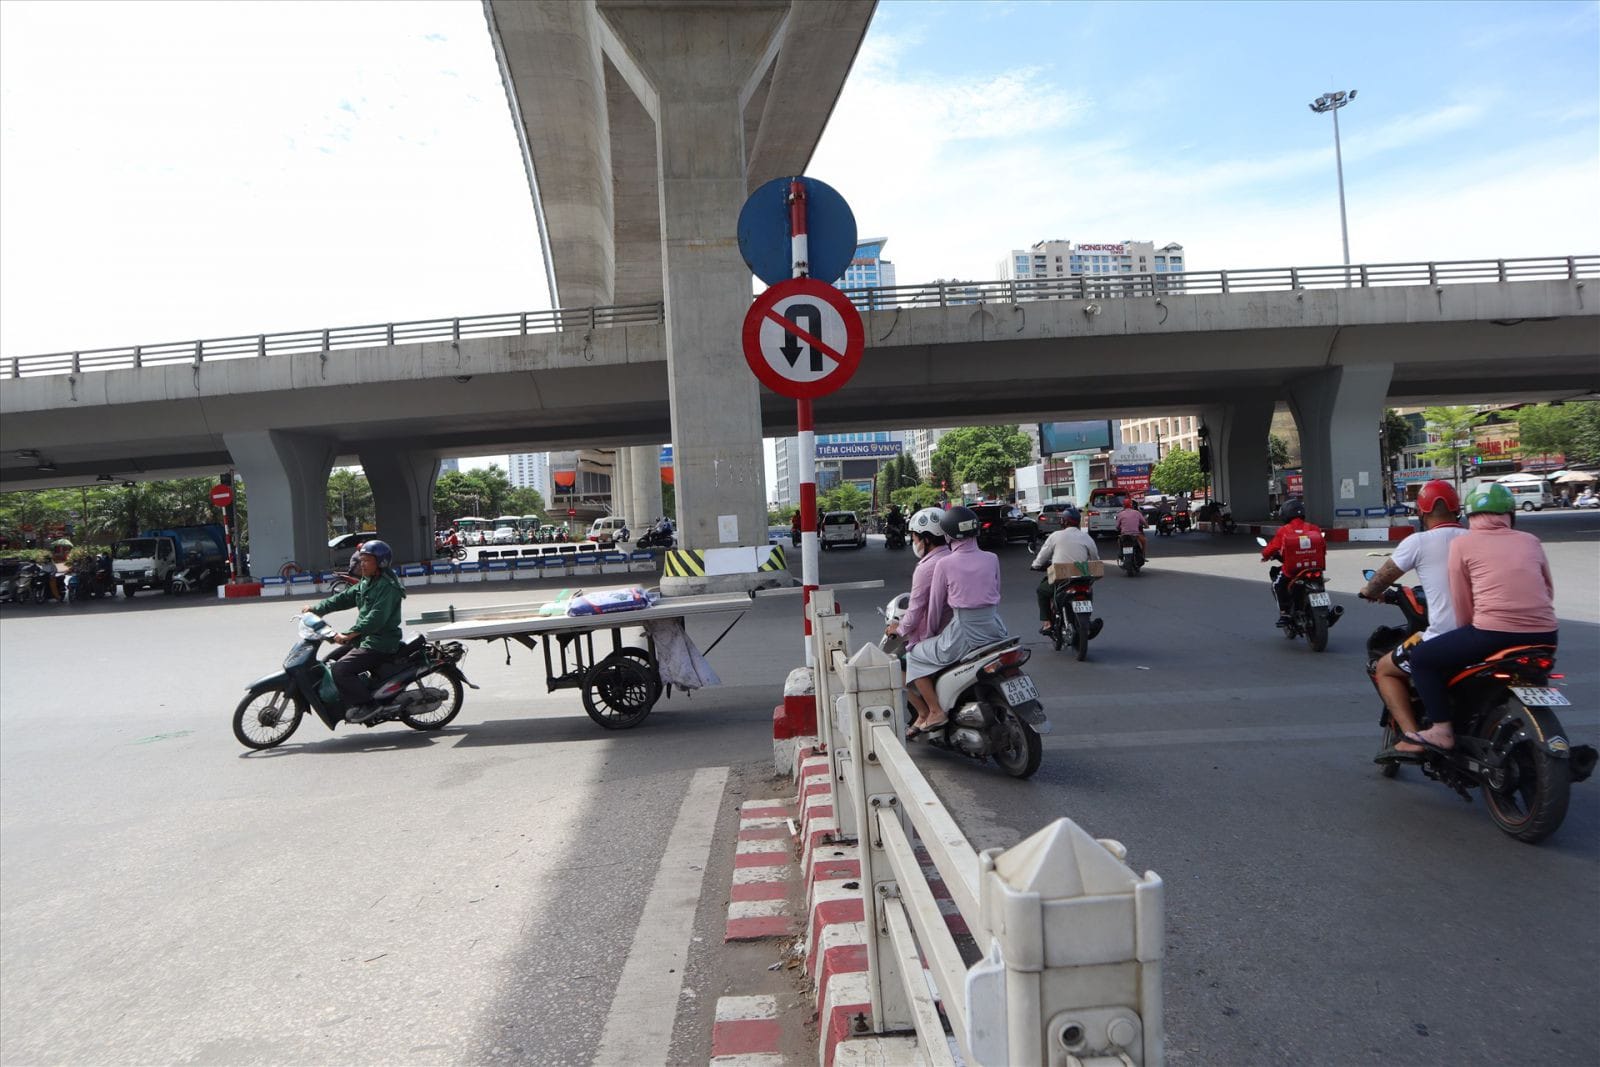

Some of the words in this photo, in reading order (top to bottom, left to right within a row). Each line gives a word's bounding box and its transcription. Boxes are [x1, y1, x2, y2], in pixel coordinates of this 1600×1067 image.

[818, 446, 839, 455] TIÊM
[878, 444, 901, 453] VNVC
[1006, 677, 1030, 693] 29-E1
